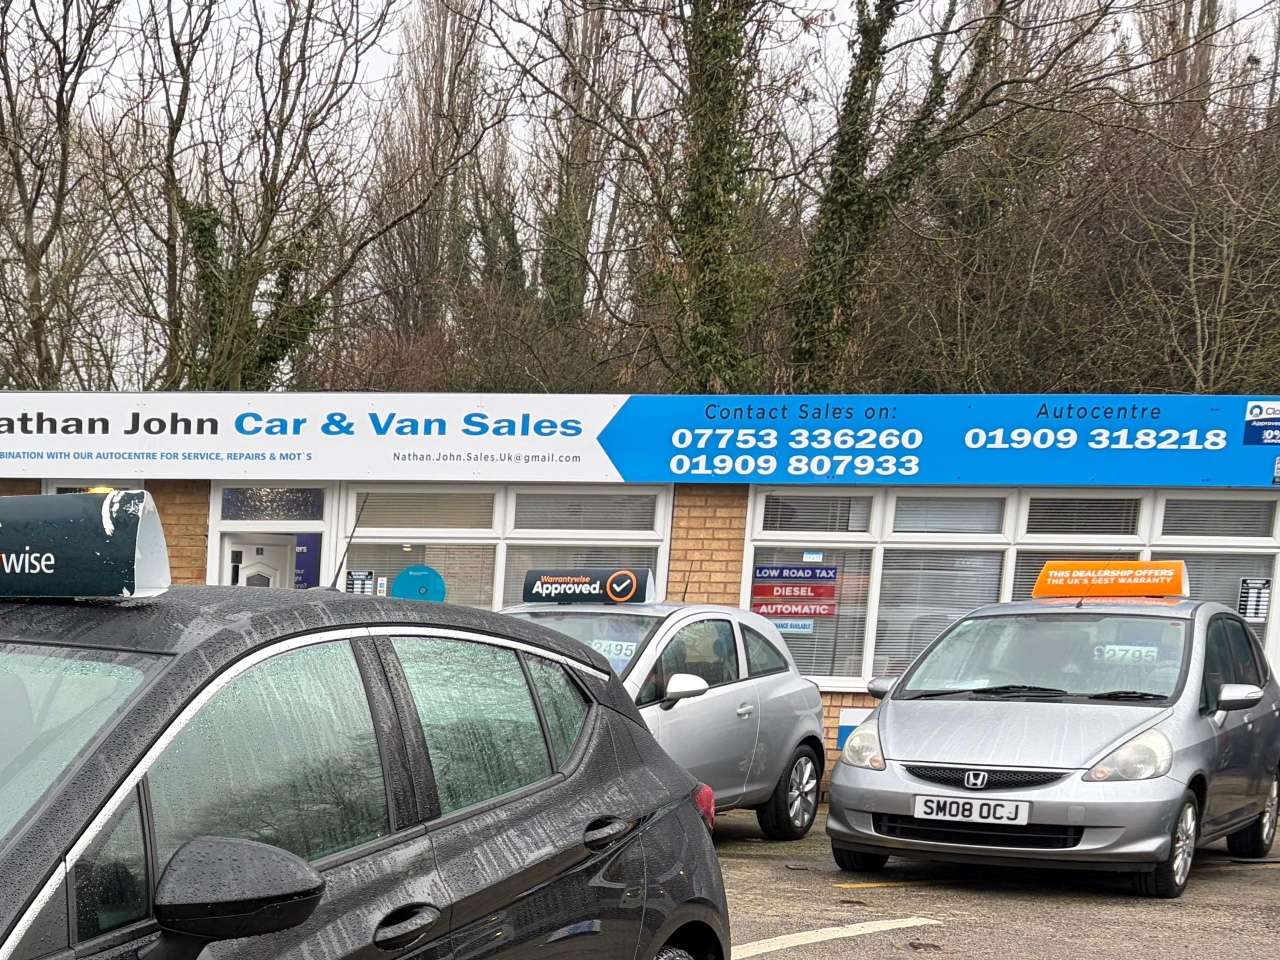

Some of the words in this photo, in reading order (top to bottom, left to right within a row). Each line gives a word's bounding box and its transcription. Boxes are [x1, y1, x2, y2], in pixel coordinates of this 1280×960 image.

[705, 403, 788, 420] Contact
[798, 403, 854, 419] Sales
[864, 405, 897, 420] on:
[1036, 403, 1162, 420] Autocentre
[123, 412, 218, 435] John
[234, 412, 307, 435] Car
[320, 412, 355, 435] &
[368, 412, 446, 435] Van
[461, 412, 583, 436] Sales
[671, 428, 778, 449] 07753
[788, 428, 923, 449] 336260
[964, 428, 1078, 449] 01909
[1087, 428, 1227, 449] 318218
[46, 451, 70, 460] WITH
[73, 451, 93, 460] OUR
[95, 452, 157, 460] AUTOCENTRE
[160, 452, 179, 460] FOR
[182, 452, 223, 462] SERVICE,
[226, 452, 266, 461] REPAIRS
[269, 452, 276, 461] &
[392, 452, 582, 464] Nathan.John.Sales.Uk@gmail.com
[669, 454, 778, 475] 01909
[786, 454, 920, 475] 807933
[541, 575, 591, 583] Warrantywise
[756, 569, 780, 577] LOW
[782, 569, 812, 577] ROAD
[815, 569, 835, 578] TAX
[1072, 569, 1134, 577] DEALERSHIP
[1091, 577, 1115, 585] BEST
[773, 587, 815, 596] DIESEL
[759, 604, 829, 614] AUTOMATIC
[923, 799, 973, 818] SM08
[979, 802, 1019, 820] OCJ
